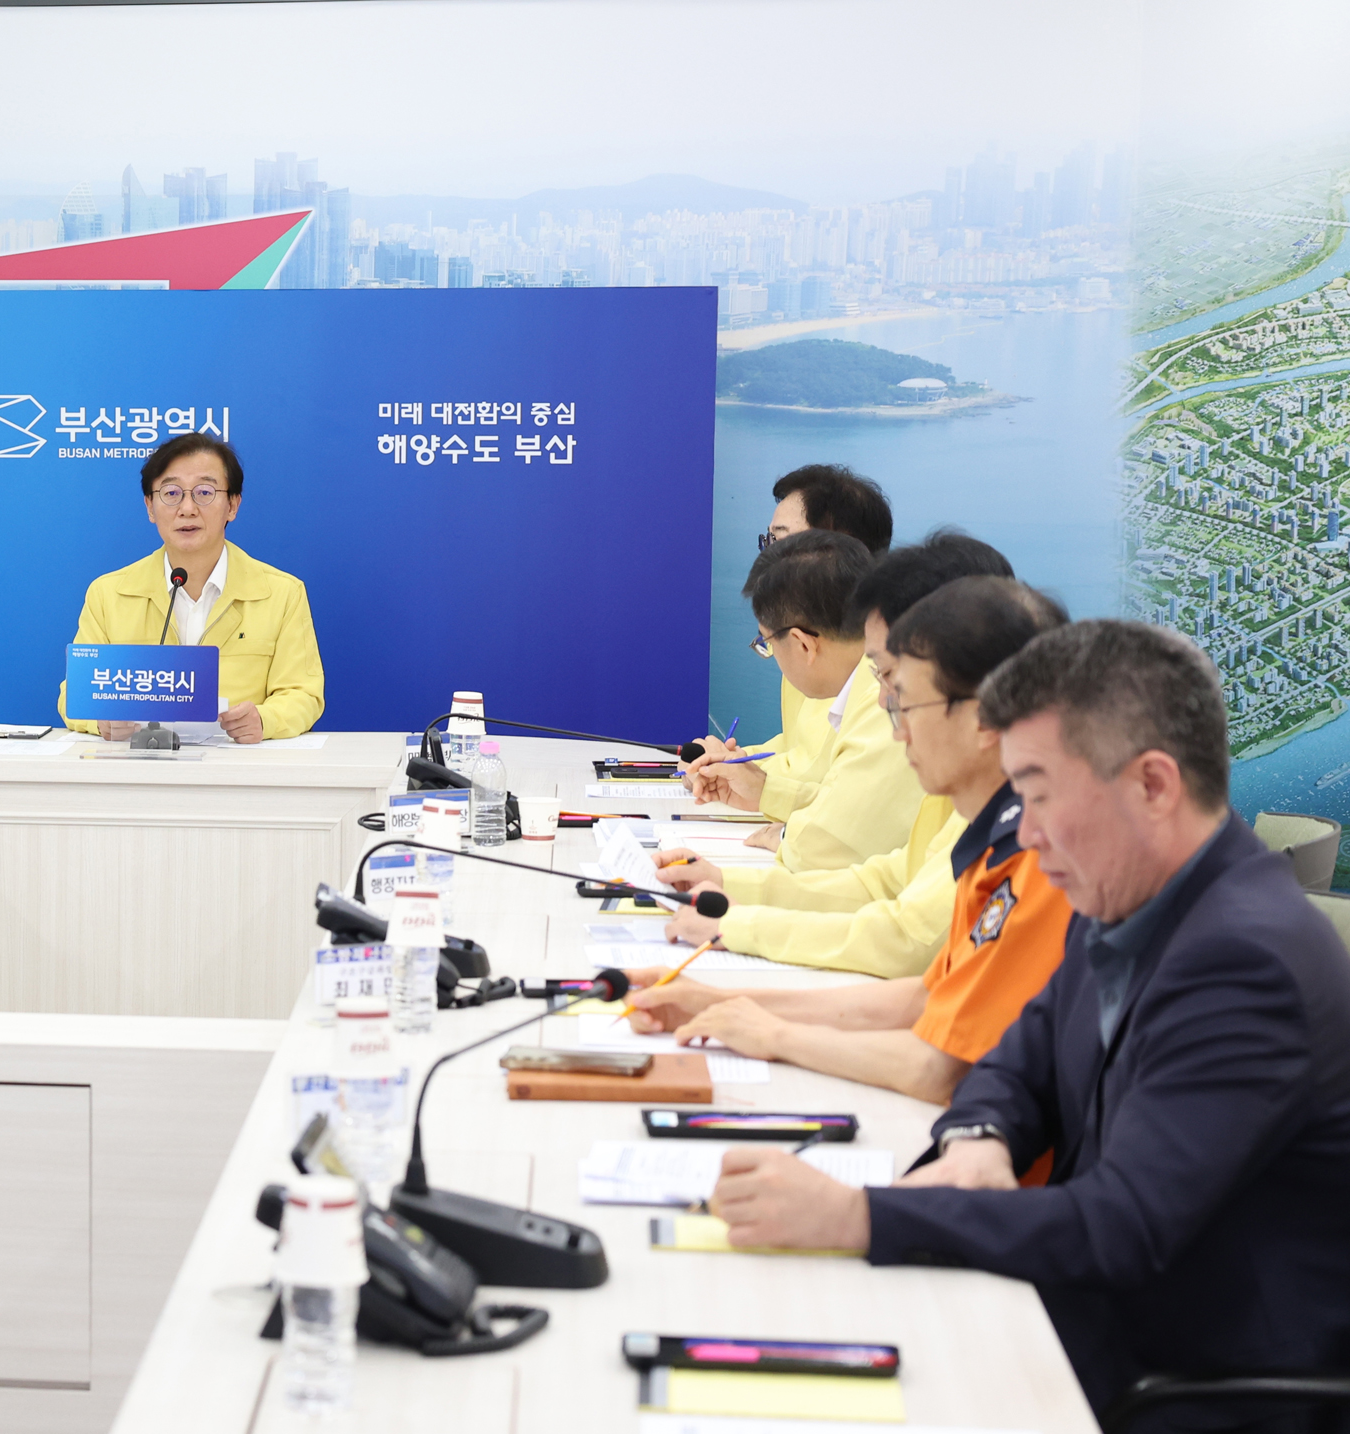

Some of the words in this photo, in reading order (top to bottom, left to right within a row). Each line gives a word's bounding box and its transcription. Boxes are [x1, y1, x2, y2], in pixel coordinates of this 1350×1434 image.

[55, 406, 230, 444] 부산광역시
[378, 402, 423, 425] 미래
[430, 401, 522, 425] 대전환의
[530, 401, 575, 427] 중심
[58, 448, 100, 459] BUSAN
[104, 448, 157, 459] METROP
[377, 434, 500, 466] 해양수도
[514, 434, 577, 464] 부산
[91, 668, 195, 693] 부산광역시
[92, 692, 118, 700] BUSAN
[119, 693, 176, 702] METROPOLITAN
[177, 695, 194, 703] CITY
